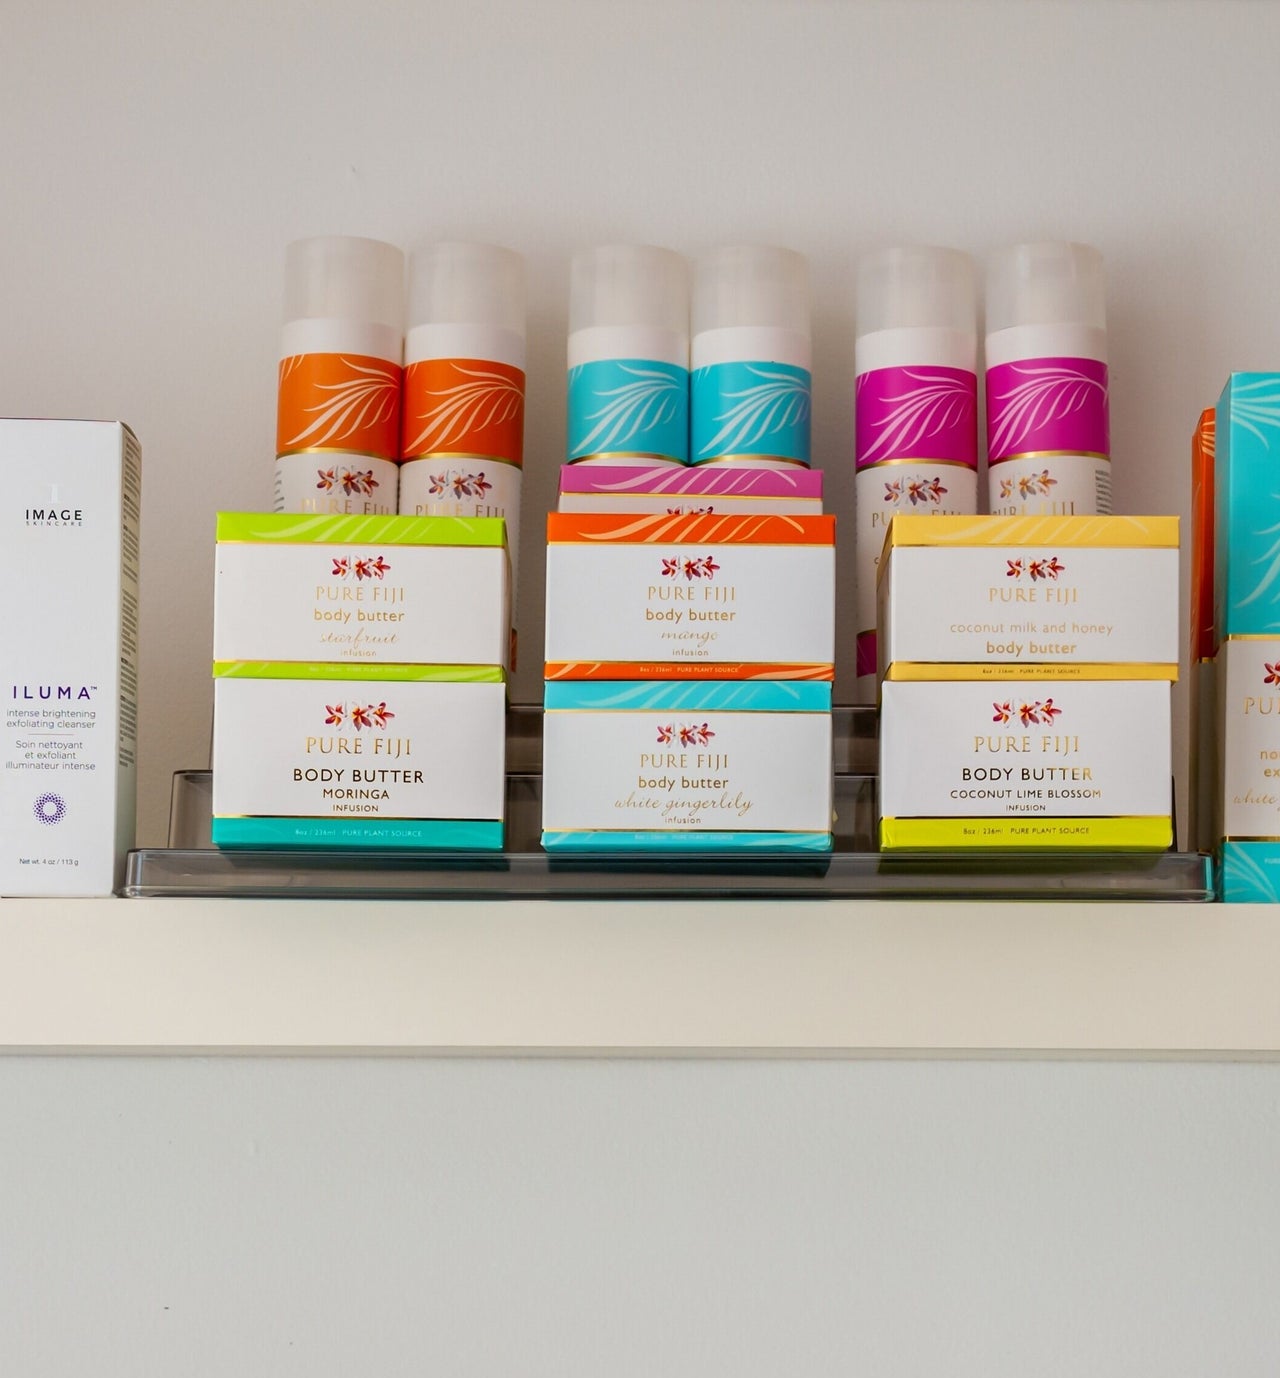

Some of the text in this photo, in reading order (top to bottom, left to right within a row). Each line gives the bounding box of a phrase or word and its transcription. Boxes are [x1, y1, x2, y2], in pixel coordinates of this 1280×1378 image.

[26, 510, 82, 520] IMAGE
[317, 586, 403, 604] PURE FIJI
[649, 586, 734, 603] PURE FIJI
[314, 608, 405, 624] body butter
[646, 608, 736, 624] body butter
[950, 622, 1112, 636] coconut milk and honey
[987, 640, 1077, 658] body butter
[7, 709, 96, 720] intense brightening
[7, 719, 95, 729] exfoliating cleanser
[16, 740, 82, 751] Soin nettoyant
[307, 737, 410, 759] PURE FIJI
[975, 736, 1078, 756] PURE FIJI
[37, 750, 76, 760] exfoliant
[641, 754, 727, 771] PURE FIJI
[294, 769, 423, 783] BODY BUTTER
[963, 768, 1092, 780] BODY BUTTER
[323, 789, 389, 799] MORINGA
[951, 790, 1100, 798] COCONUT LIME BLOSSOM
[333, 805, 378, 813] INFUSION
